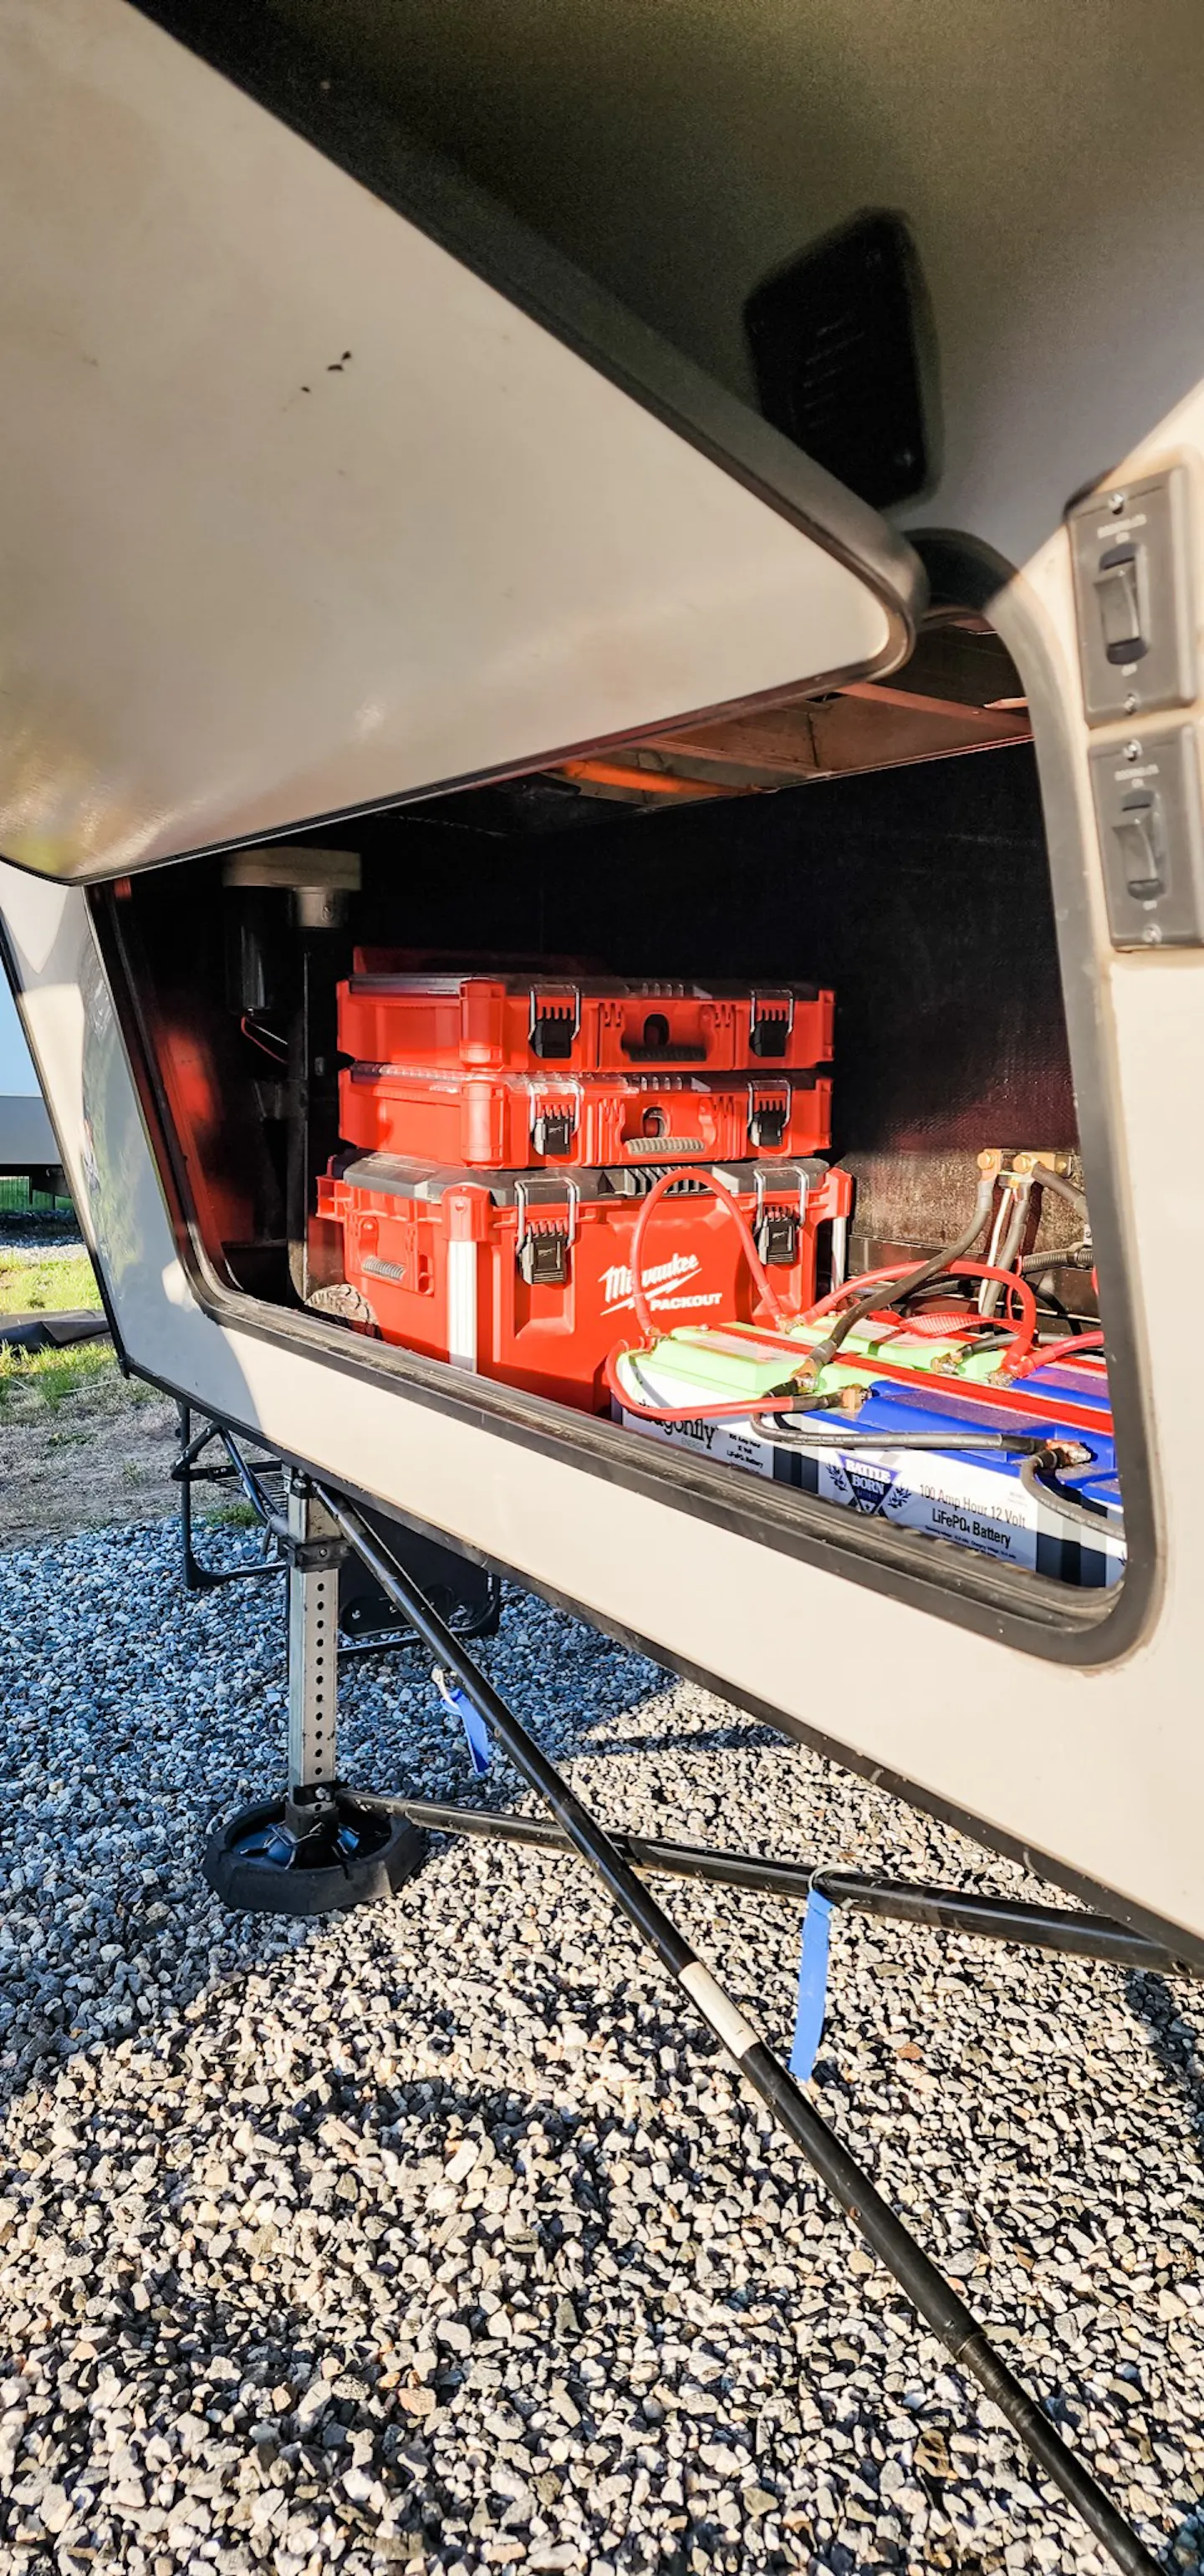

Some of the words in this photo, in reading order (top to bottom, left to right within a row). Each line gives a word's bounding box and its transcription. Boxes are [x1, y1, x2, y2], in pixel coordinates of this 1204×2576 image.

[598, 1253, 699, 1302] Miwaukee
[650, 1293, 723, 1311] PACKOUT
[844, 1458, 892, 1484] BATTLE
[851, 1474, 885, 1495] BORN
[920, 1484, 936, 1500] 100
[937, 1489, 961, 1511] Amp
[963, 1496, 987, 1516] Hour
[991, 1506, 1002, 1521] 12
[1005, 1509, 1026, 1529] Volt
[972, 1520, 1012, 1549] Battery
